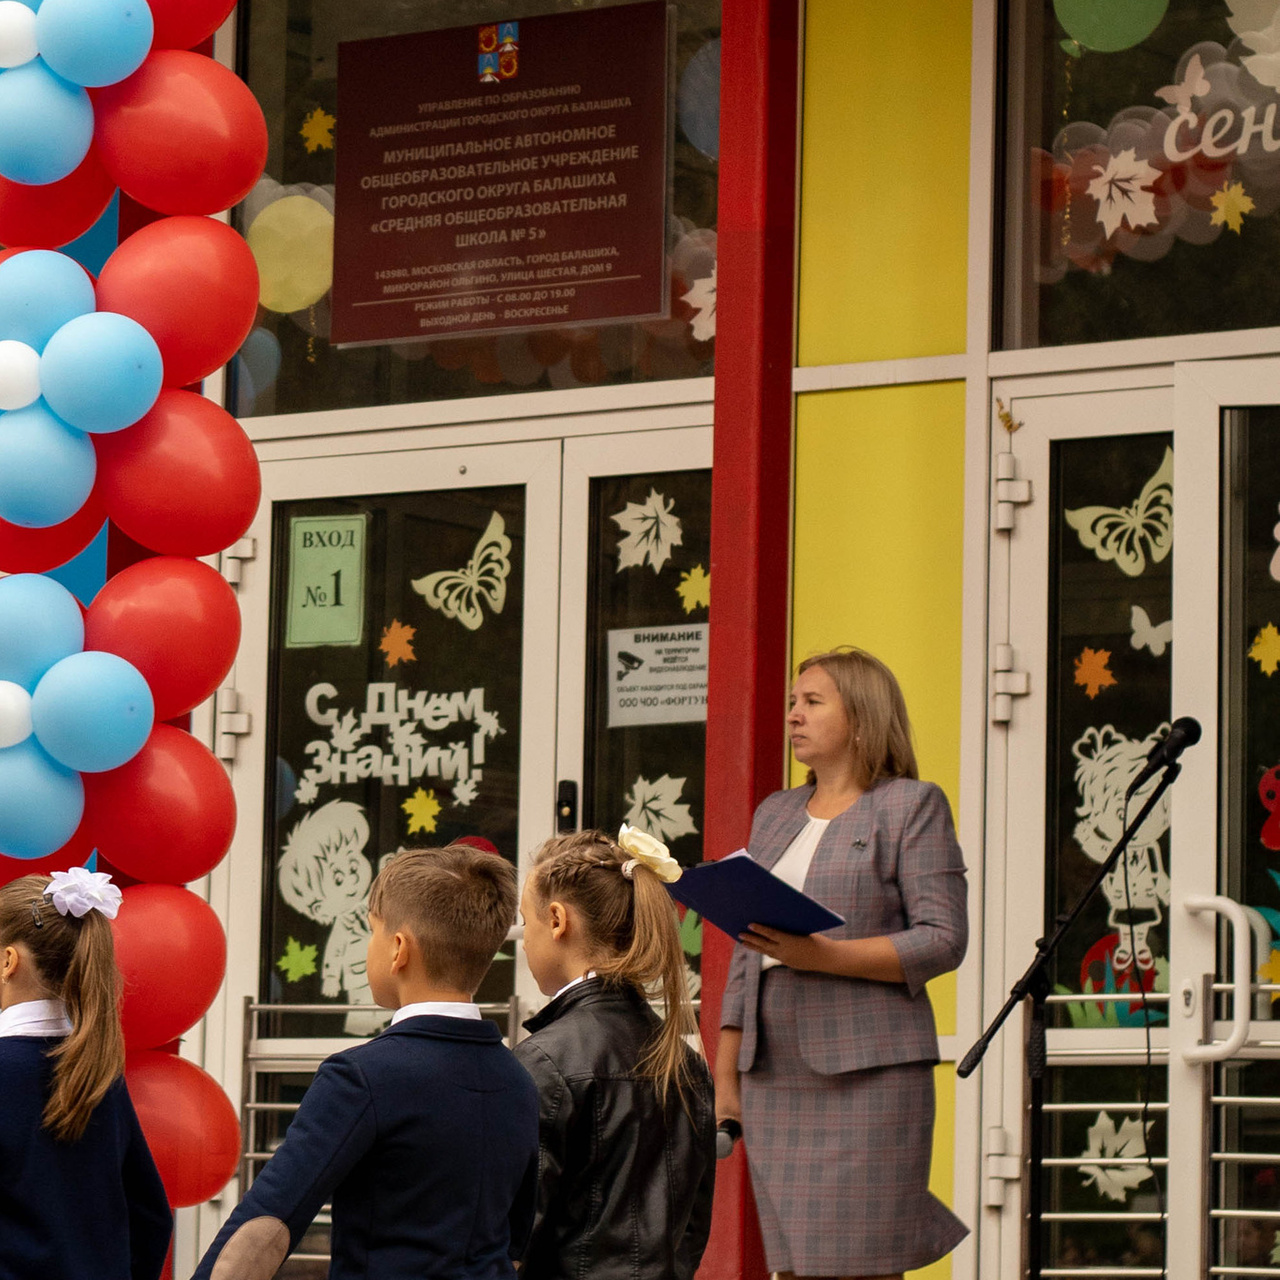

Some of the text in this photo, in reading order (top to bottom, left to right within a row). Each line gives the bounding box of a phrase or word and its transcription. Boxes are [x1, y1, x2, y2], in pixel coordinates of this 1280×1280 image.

[419, 84, 581, 113] УПРАВЛЕНИЕ ПО ОБРАЗОВАНИЮ
[370, 97, 632, 138] АДМИНИСТРАЦИИ ГОРОДСКОГО ОКРУГА БАЛАШИХА
[383, 124, 616, 163] МУНИЦИПАЛЬНОЕ АВТОНОМНОЕ
[361, 145, 639, 189] ОБЩЕОБРАЗОВАТЕЛЬНОЕ УЧРЕЖДЕНИЕ
[381, 171, 617, 210] ГОРОДСКОГО ОКРУГА БАЛАШИХА
[371, 193, 627, 234] «СРЕДНЯЯ ОБЩЕОБРАЗОВАТЕЛЬНАЯ
[455, 231, 507, 248] ШКОЛА
[411, 260, 476, 276] МОСКОВСКАЯ
[477, 255, 524, 269] ОБЛАСТЬ,
[526, 253, 560, 265] ГОРОД
[561, 246, 619, 261] БАЛАШИХА,
[383, 279, 450, 294] МИКРОРАЙОН
[451, 273, 499, 287] ОЛЬГИНО,
[501, 270, 534, 282] УЛИЦА
[537, 266, 578, 278] ШЕСТАЯ,
[580, 264, 604, 276] ДОМ
[414, 300, 449, 312] РЕЖИМ
[451, 296, 490, 308] РАБОТЫ
[504, 291, 532, 302] 08.00
[532, 290, 548, 301] ДО
[550, 288, 576, 299] 19.00
[420, 312, 470, 327] ВЫХОДНОЙ
[472, 311, 496, 323] ДЕНЬ
[504, 304, 569, 319] ВОСКРЕСЕНЬЕ
[302, 529, 355, 550] ВХОД
[634, 630, 703, 643] ВНИМАНИЕ
[305, 682, 339, 726] С
[619, 698, 638, 708] ООО
[304, 728, 485, 786] Знаний!
